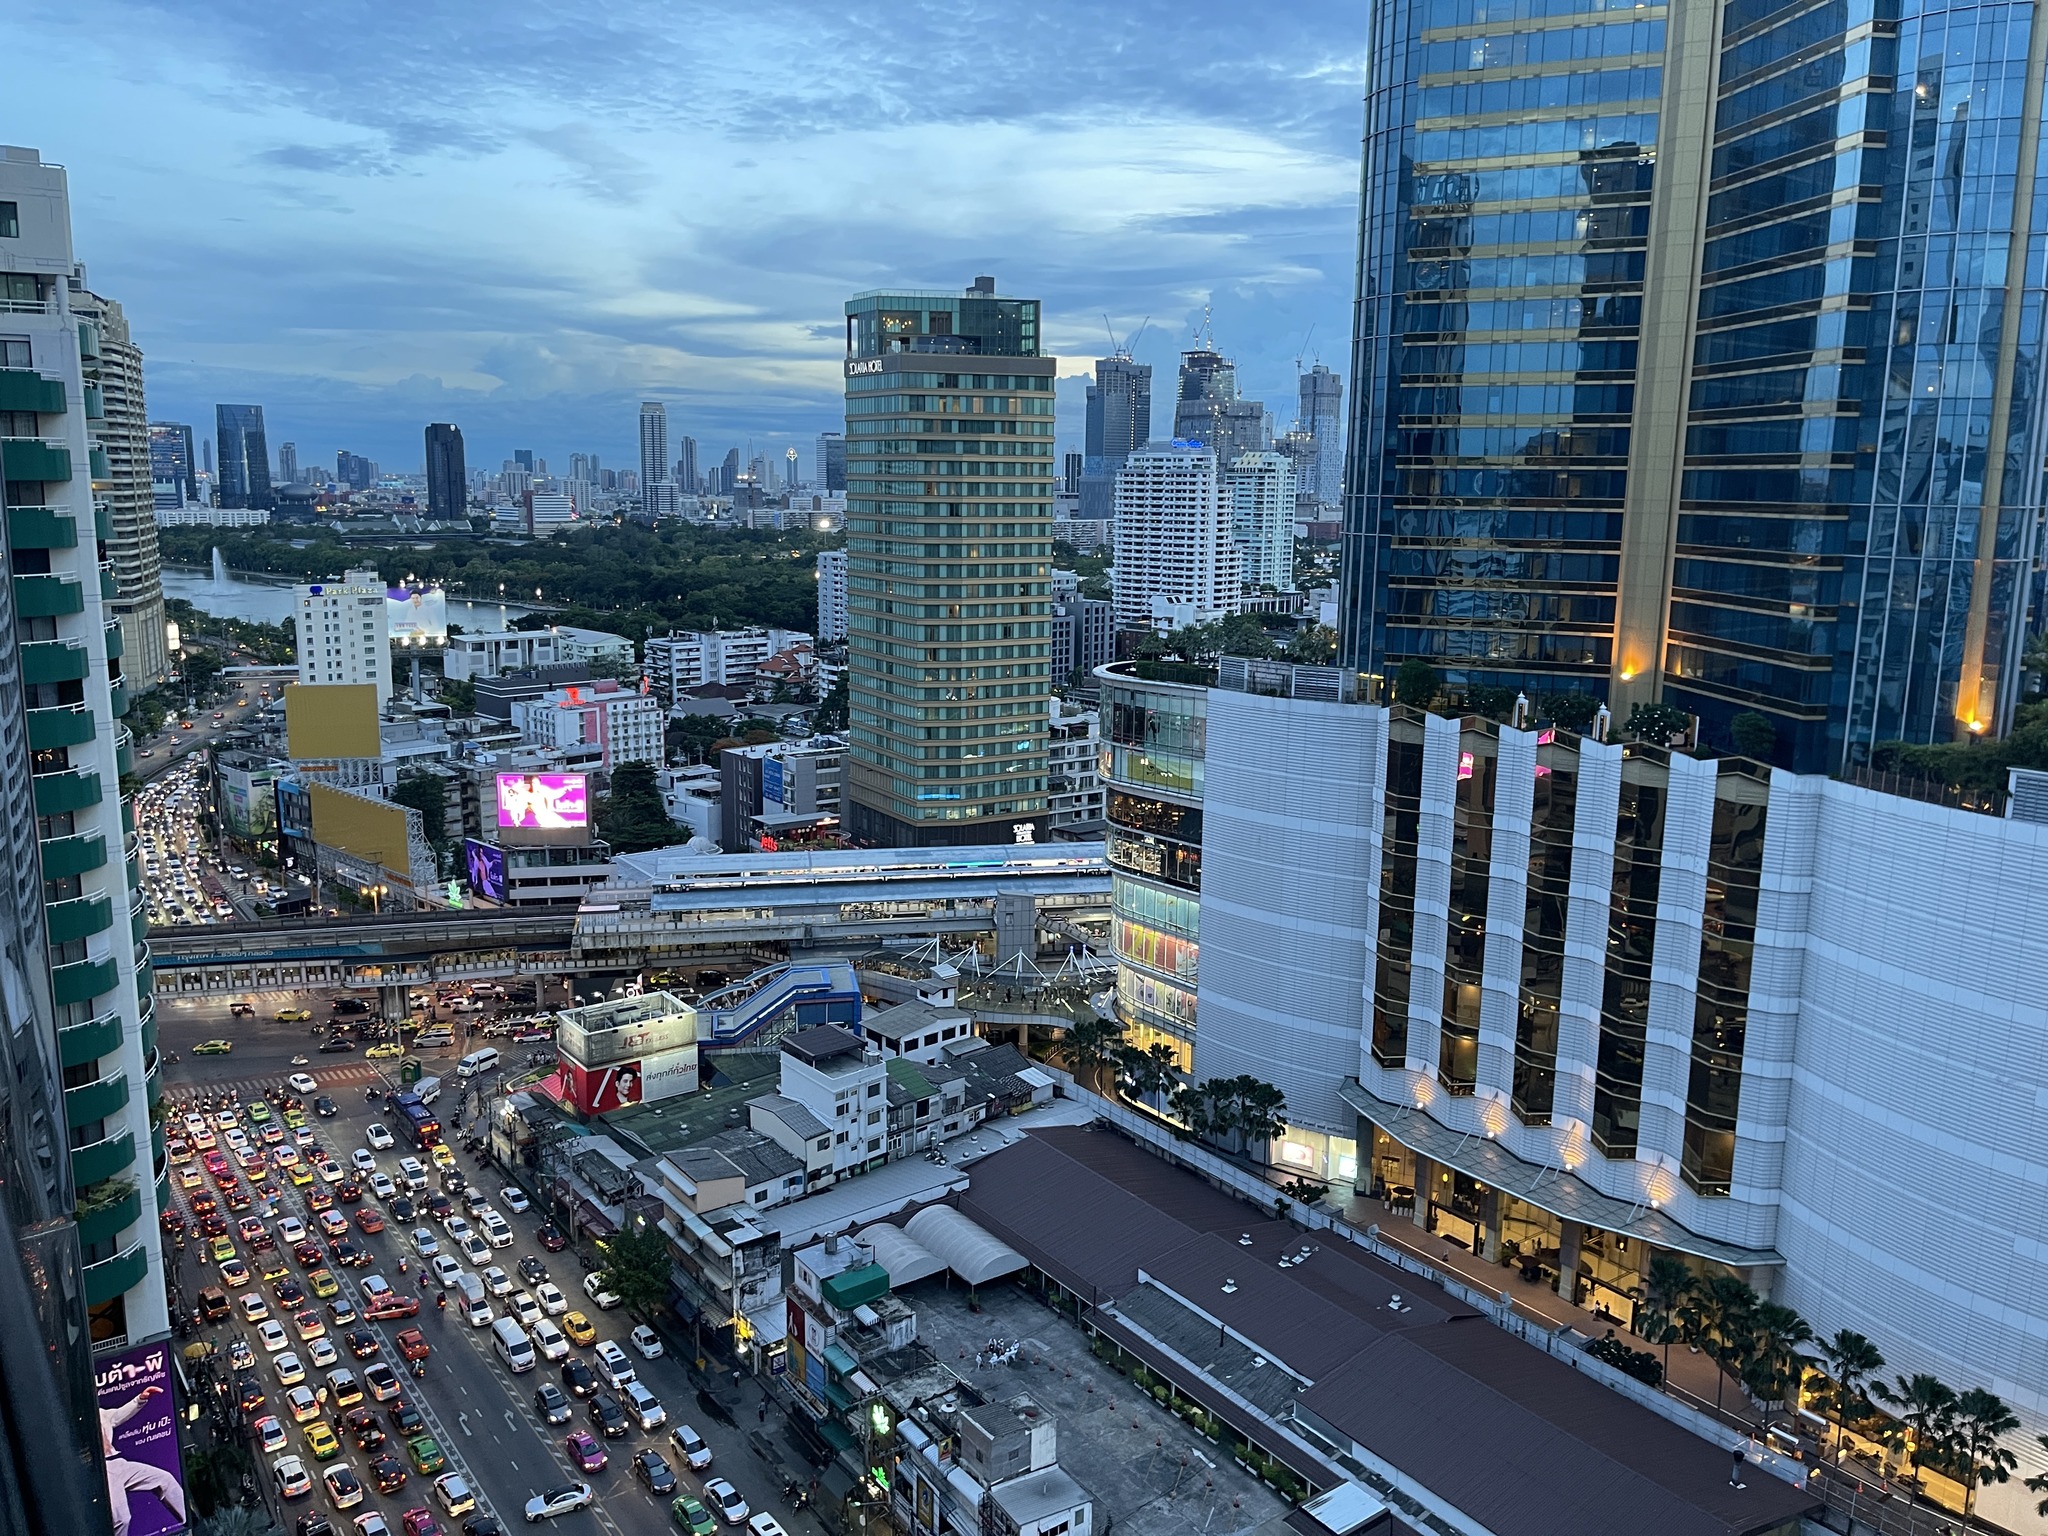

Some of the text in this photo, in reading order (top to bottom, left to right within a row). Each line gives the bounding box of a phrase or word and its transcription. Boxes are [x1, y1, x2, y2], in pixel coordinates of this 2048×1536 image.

[325, 585, 378, 596] Park Plaza
[645, 1034, 669, 1046] EXESS
